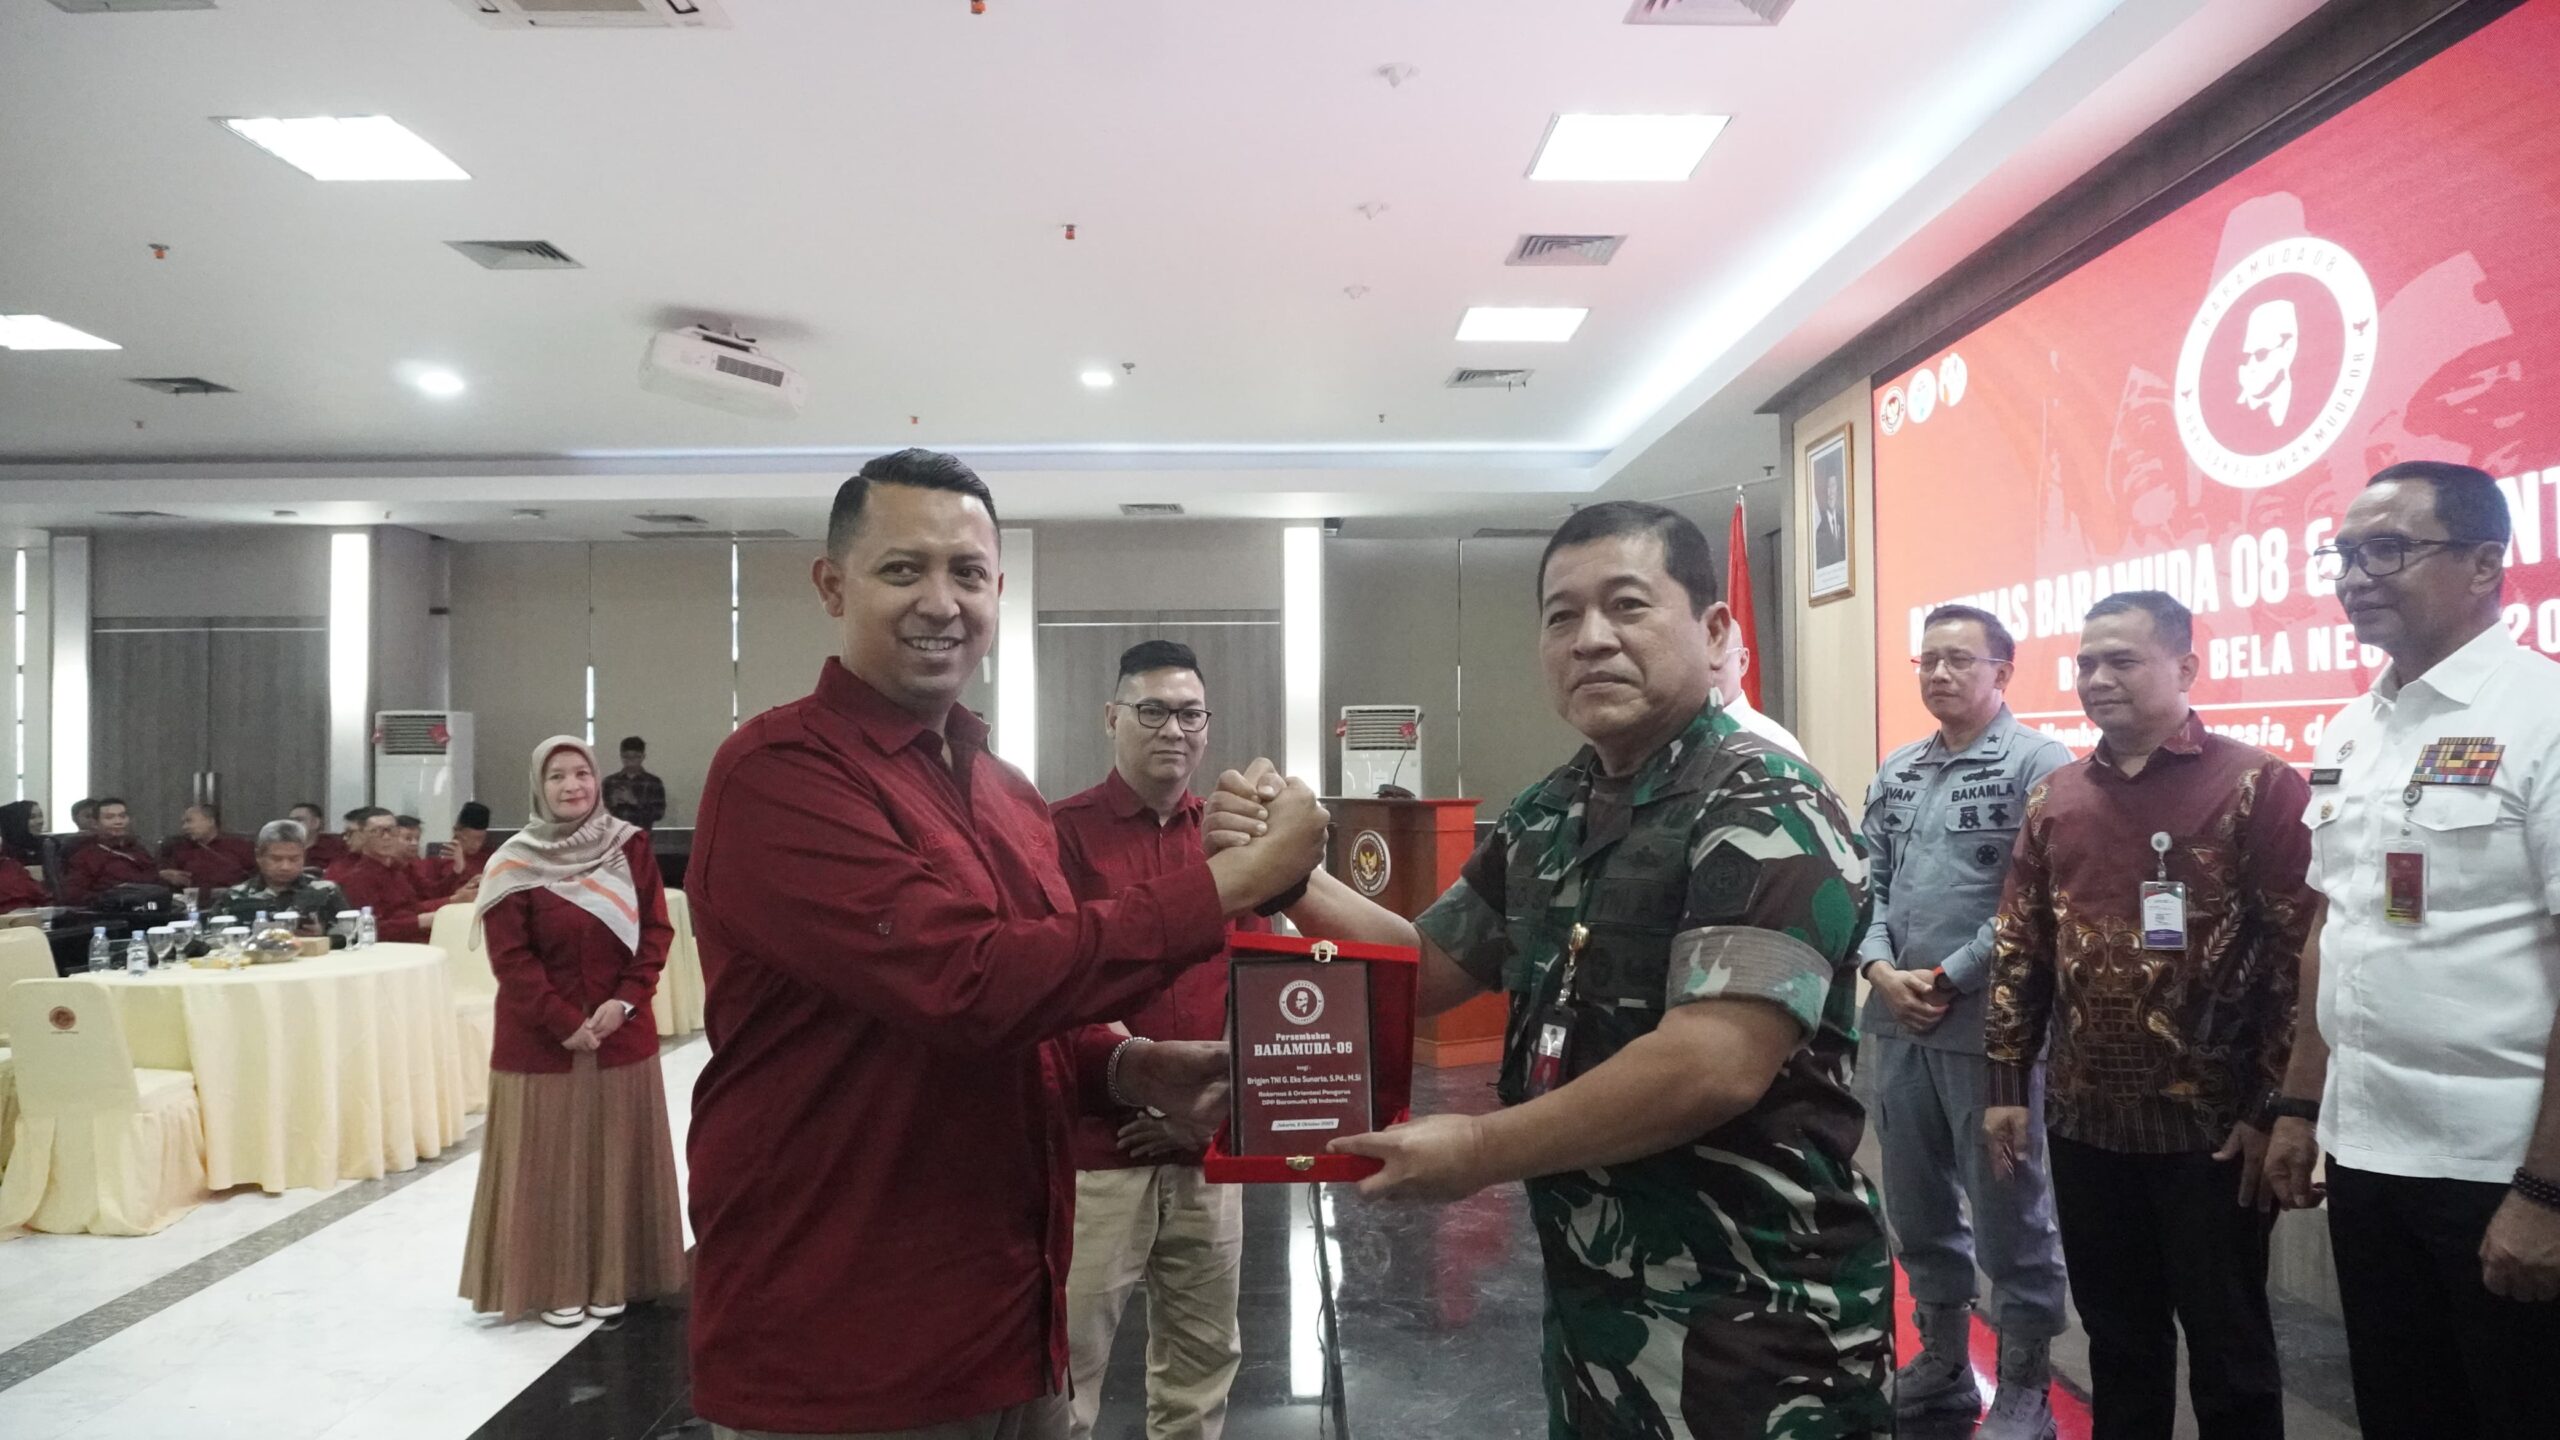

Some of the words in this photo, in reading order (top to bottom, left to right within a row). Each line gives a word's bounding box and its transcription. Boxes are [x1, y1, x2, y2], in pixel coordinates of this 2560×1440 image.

[2230, 527, 2289, 608] 08
[2209, 631, 2293, 680] BELA
[1951, 782, 2015, 802] BAKAMLA
[1254, 1041, 1353, 1057] BARAMUDA-08
[1247, 1077, 1270, 1087] Brigjen
[1270, 1076, 1282, 1084] TNI
